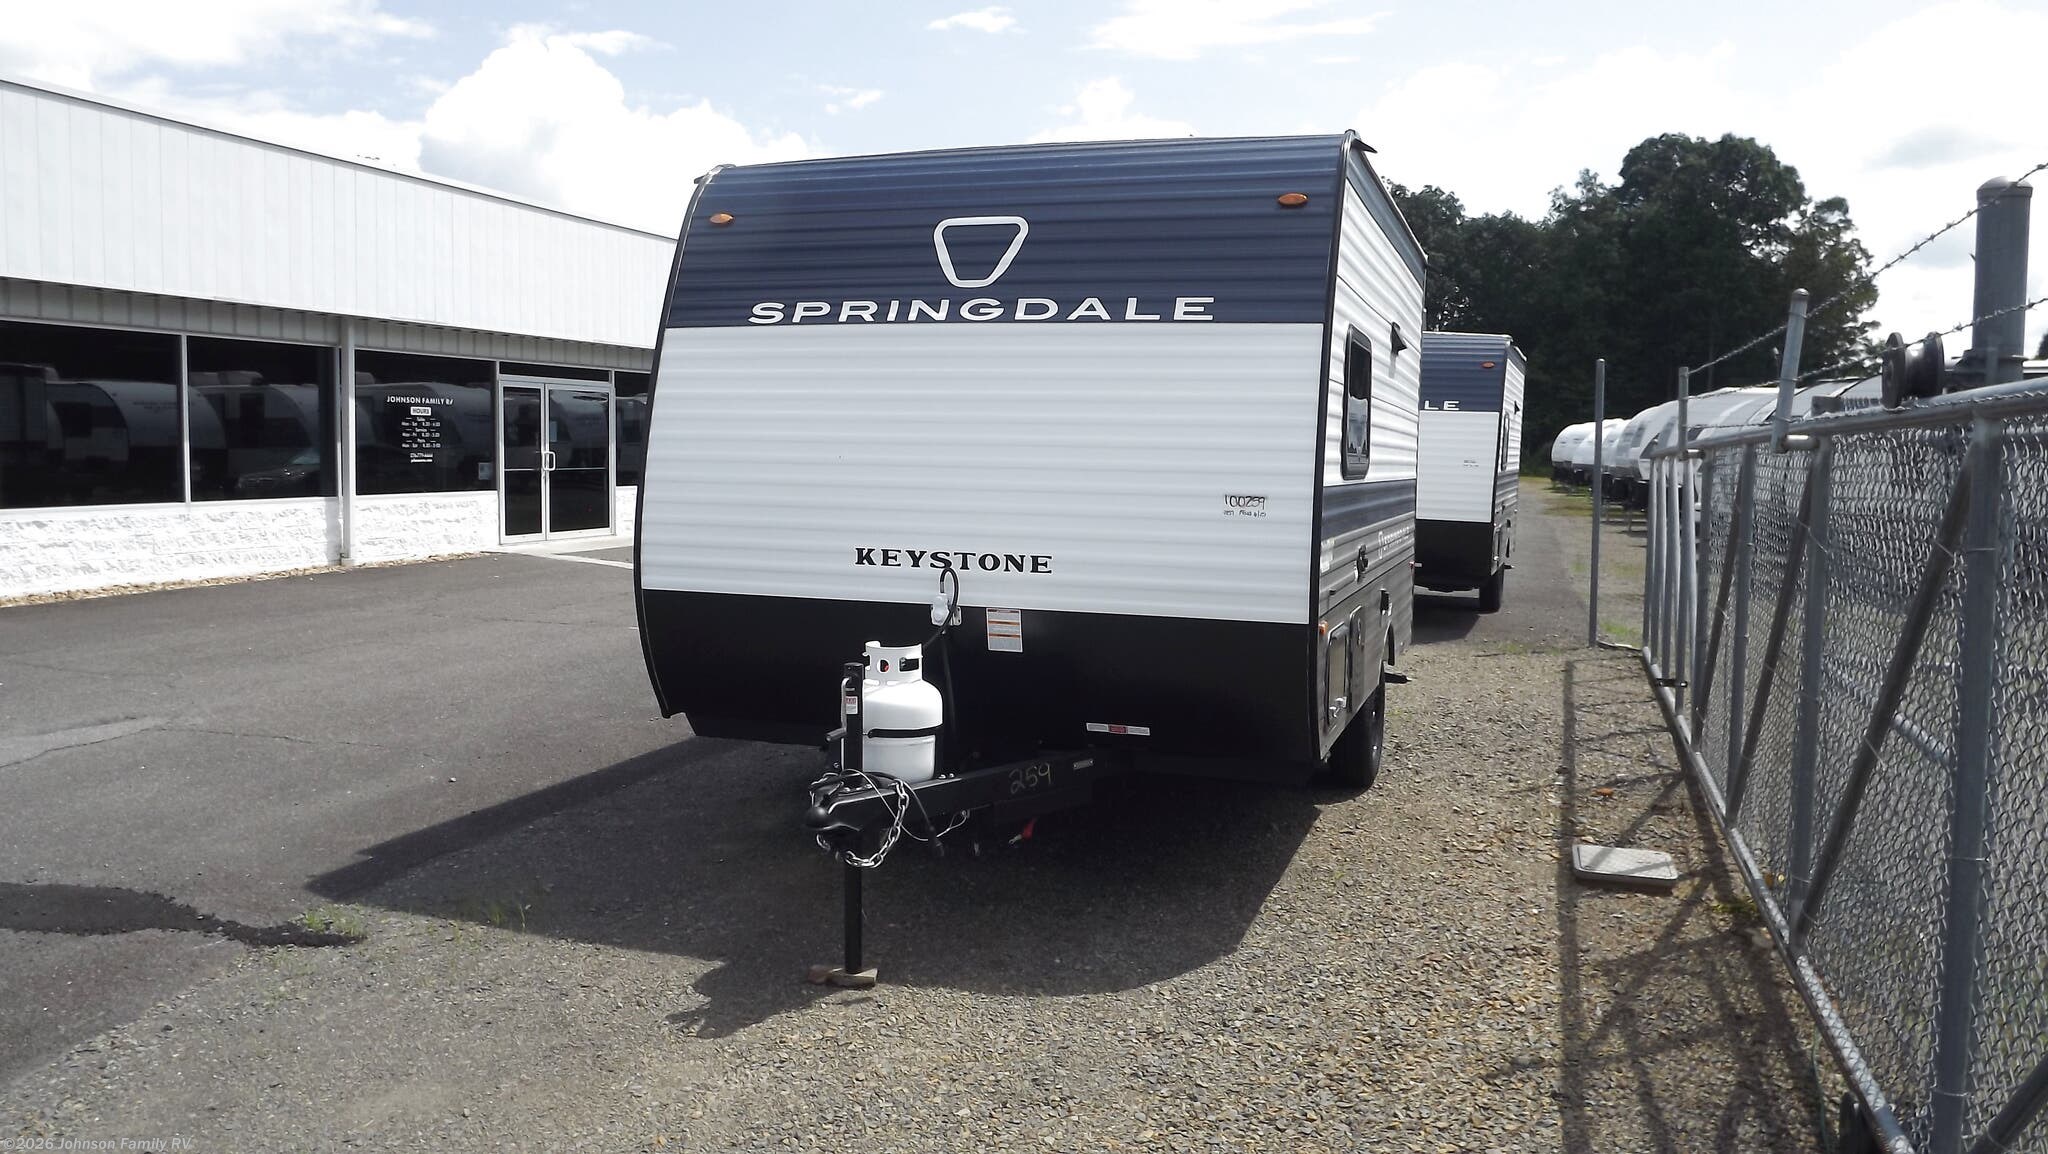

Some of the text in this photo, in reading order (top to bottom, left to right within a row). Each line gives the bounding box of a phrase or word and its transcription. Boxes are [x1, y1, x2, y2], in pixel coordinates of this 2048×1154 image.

[748, 297, 1215, 323] SPRINGDALE
[386, 395, 421, 404] JOHNSON
[421, 397, 445, 405] FAMILY
[1224, 494, 1266, 510] 100259
[855, 547, 1053, 574] KEYSTONE
[1008, 762, 1052, 794] 259
